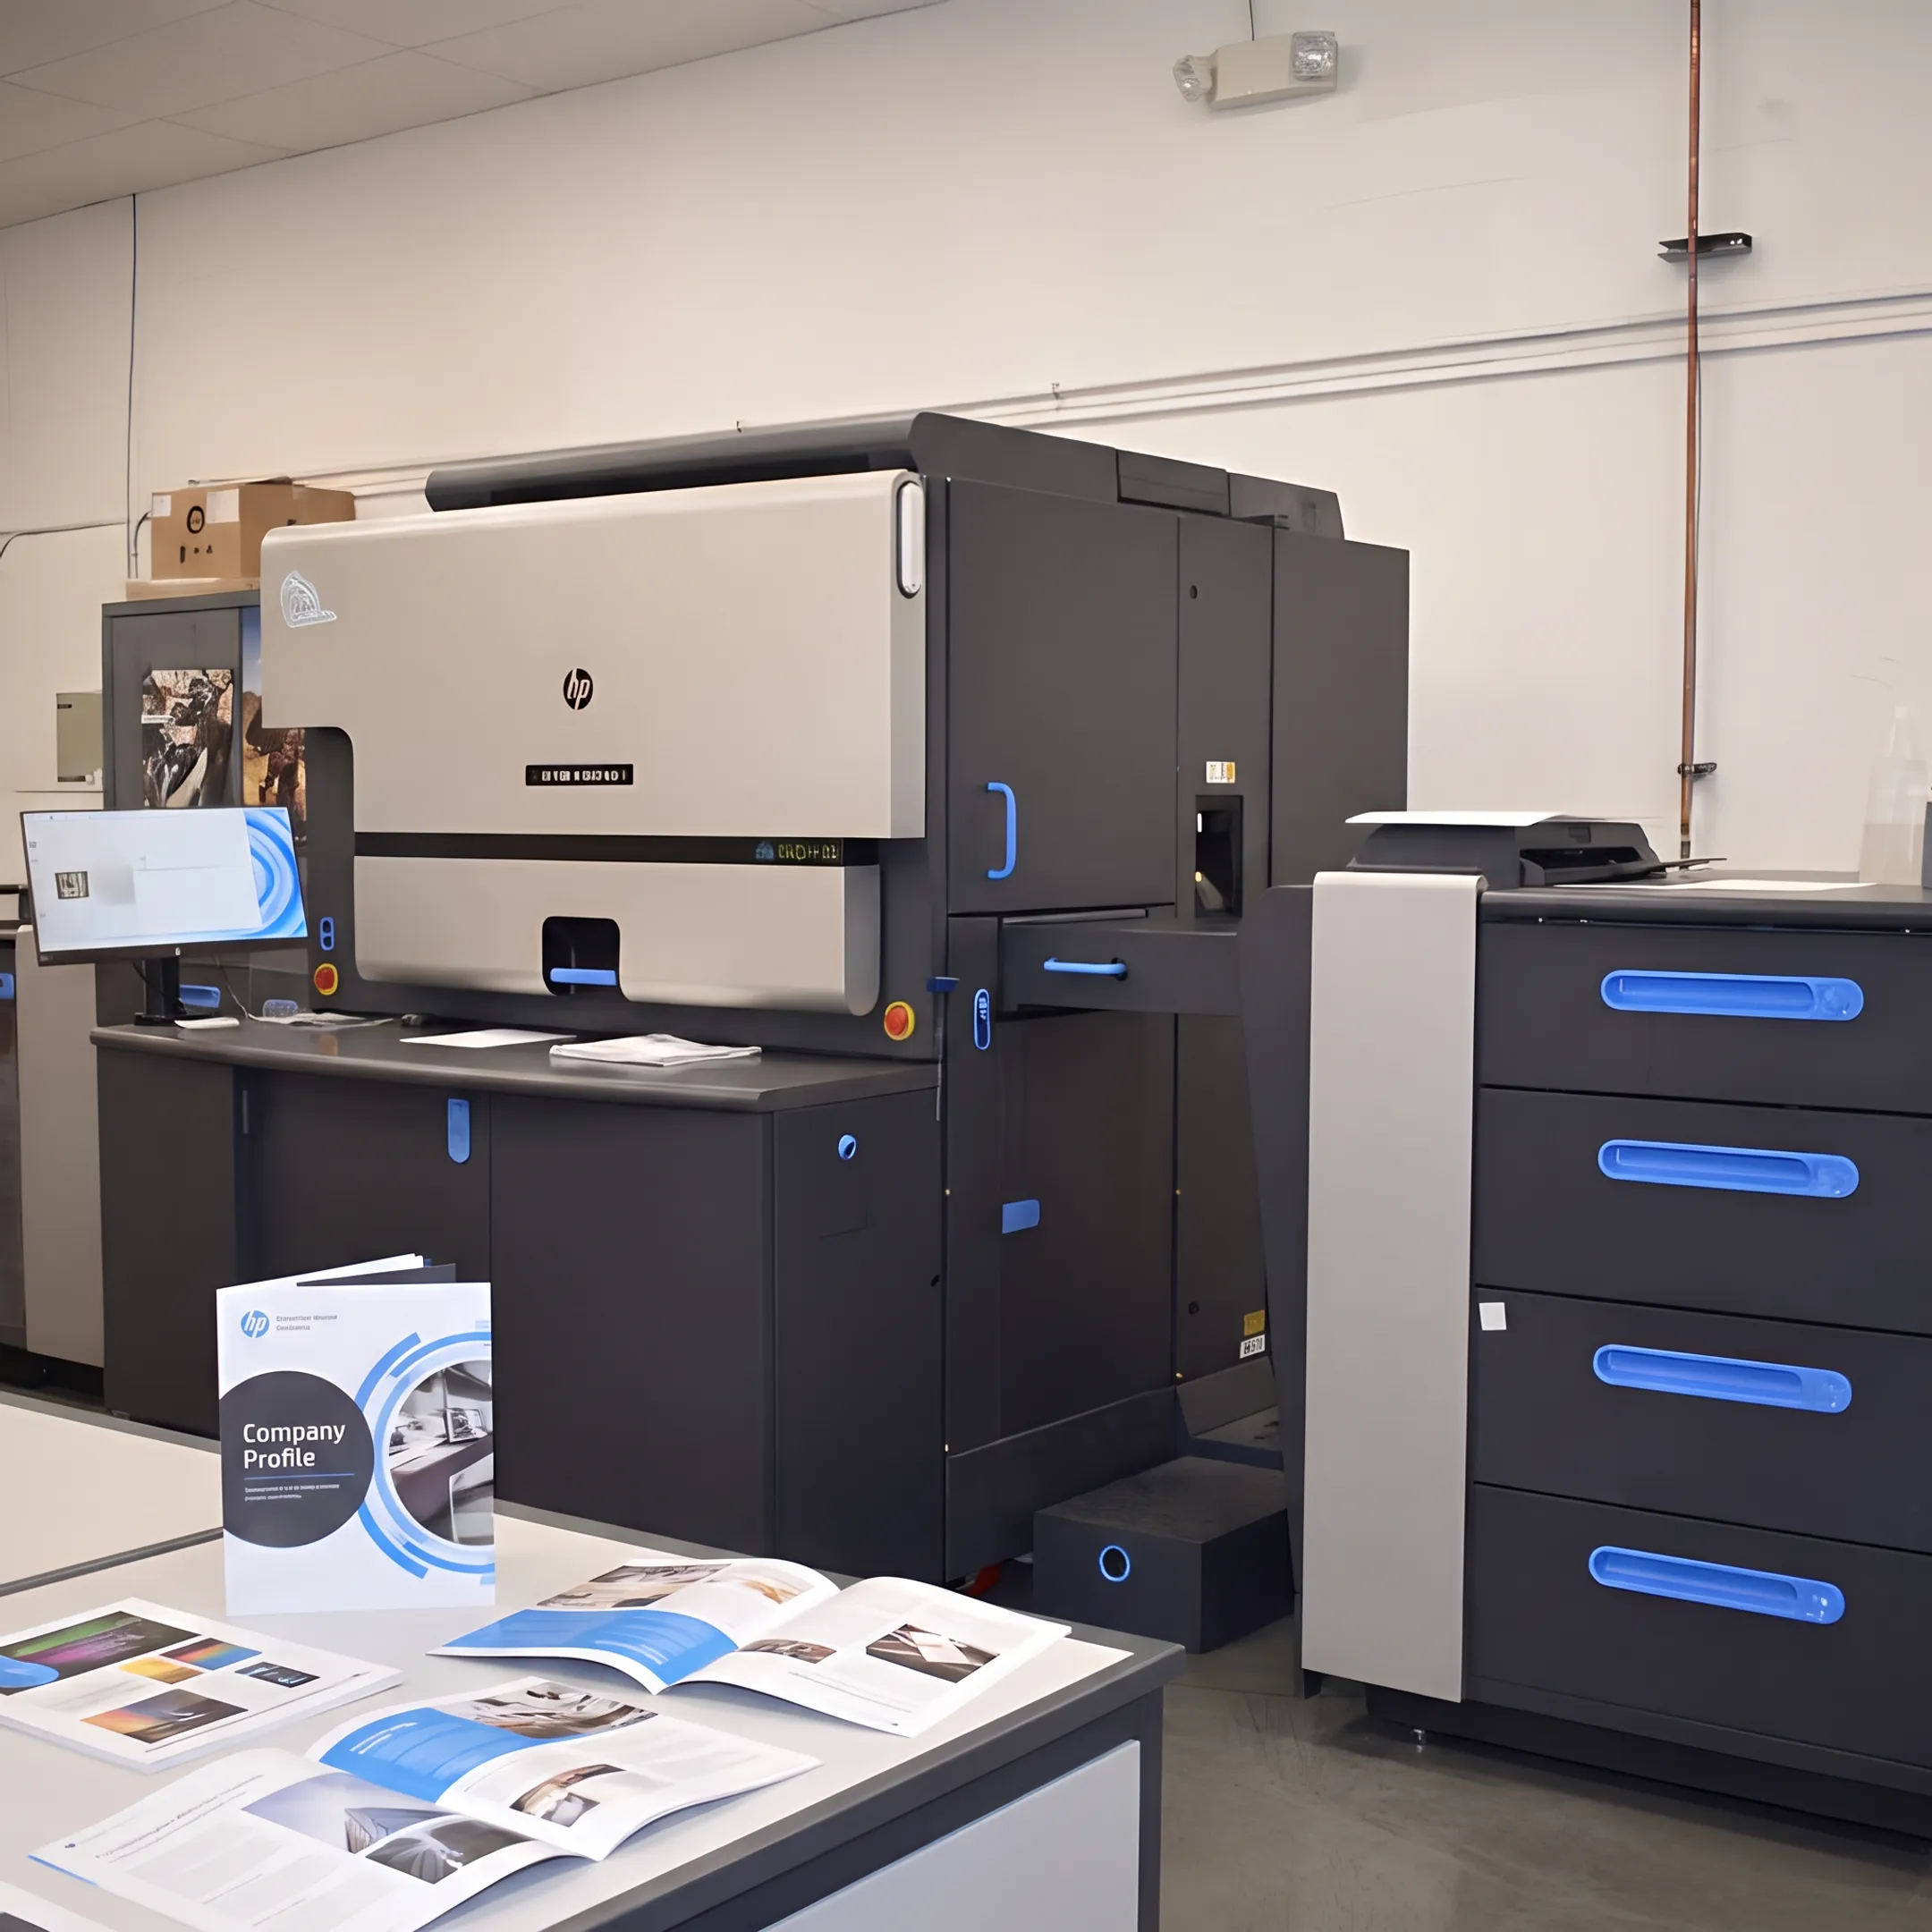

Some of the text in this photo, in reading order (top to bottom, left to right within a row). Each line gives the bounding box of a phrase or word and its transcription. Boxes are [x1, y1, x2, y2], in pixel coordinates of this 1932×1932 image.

[565, 667, 591, 711] hp
[242, 1309, 268, 1338] hp
[242, 1423, 346, 1445] Company
[242, 1447, 317, 1470] Profile
